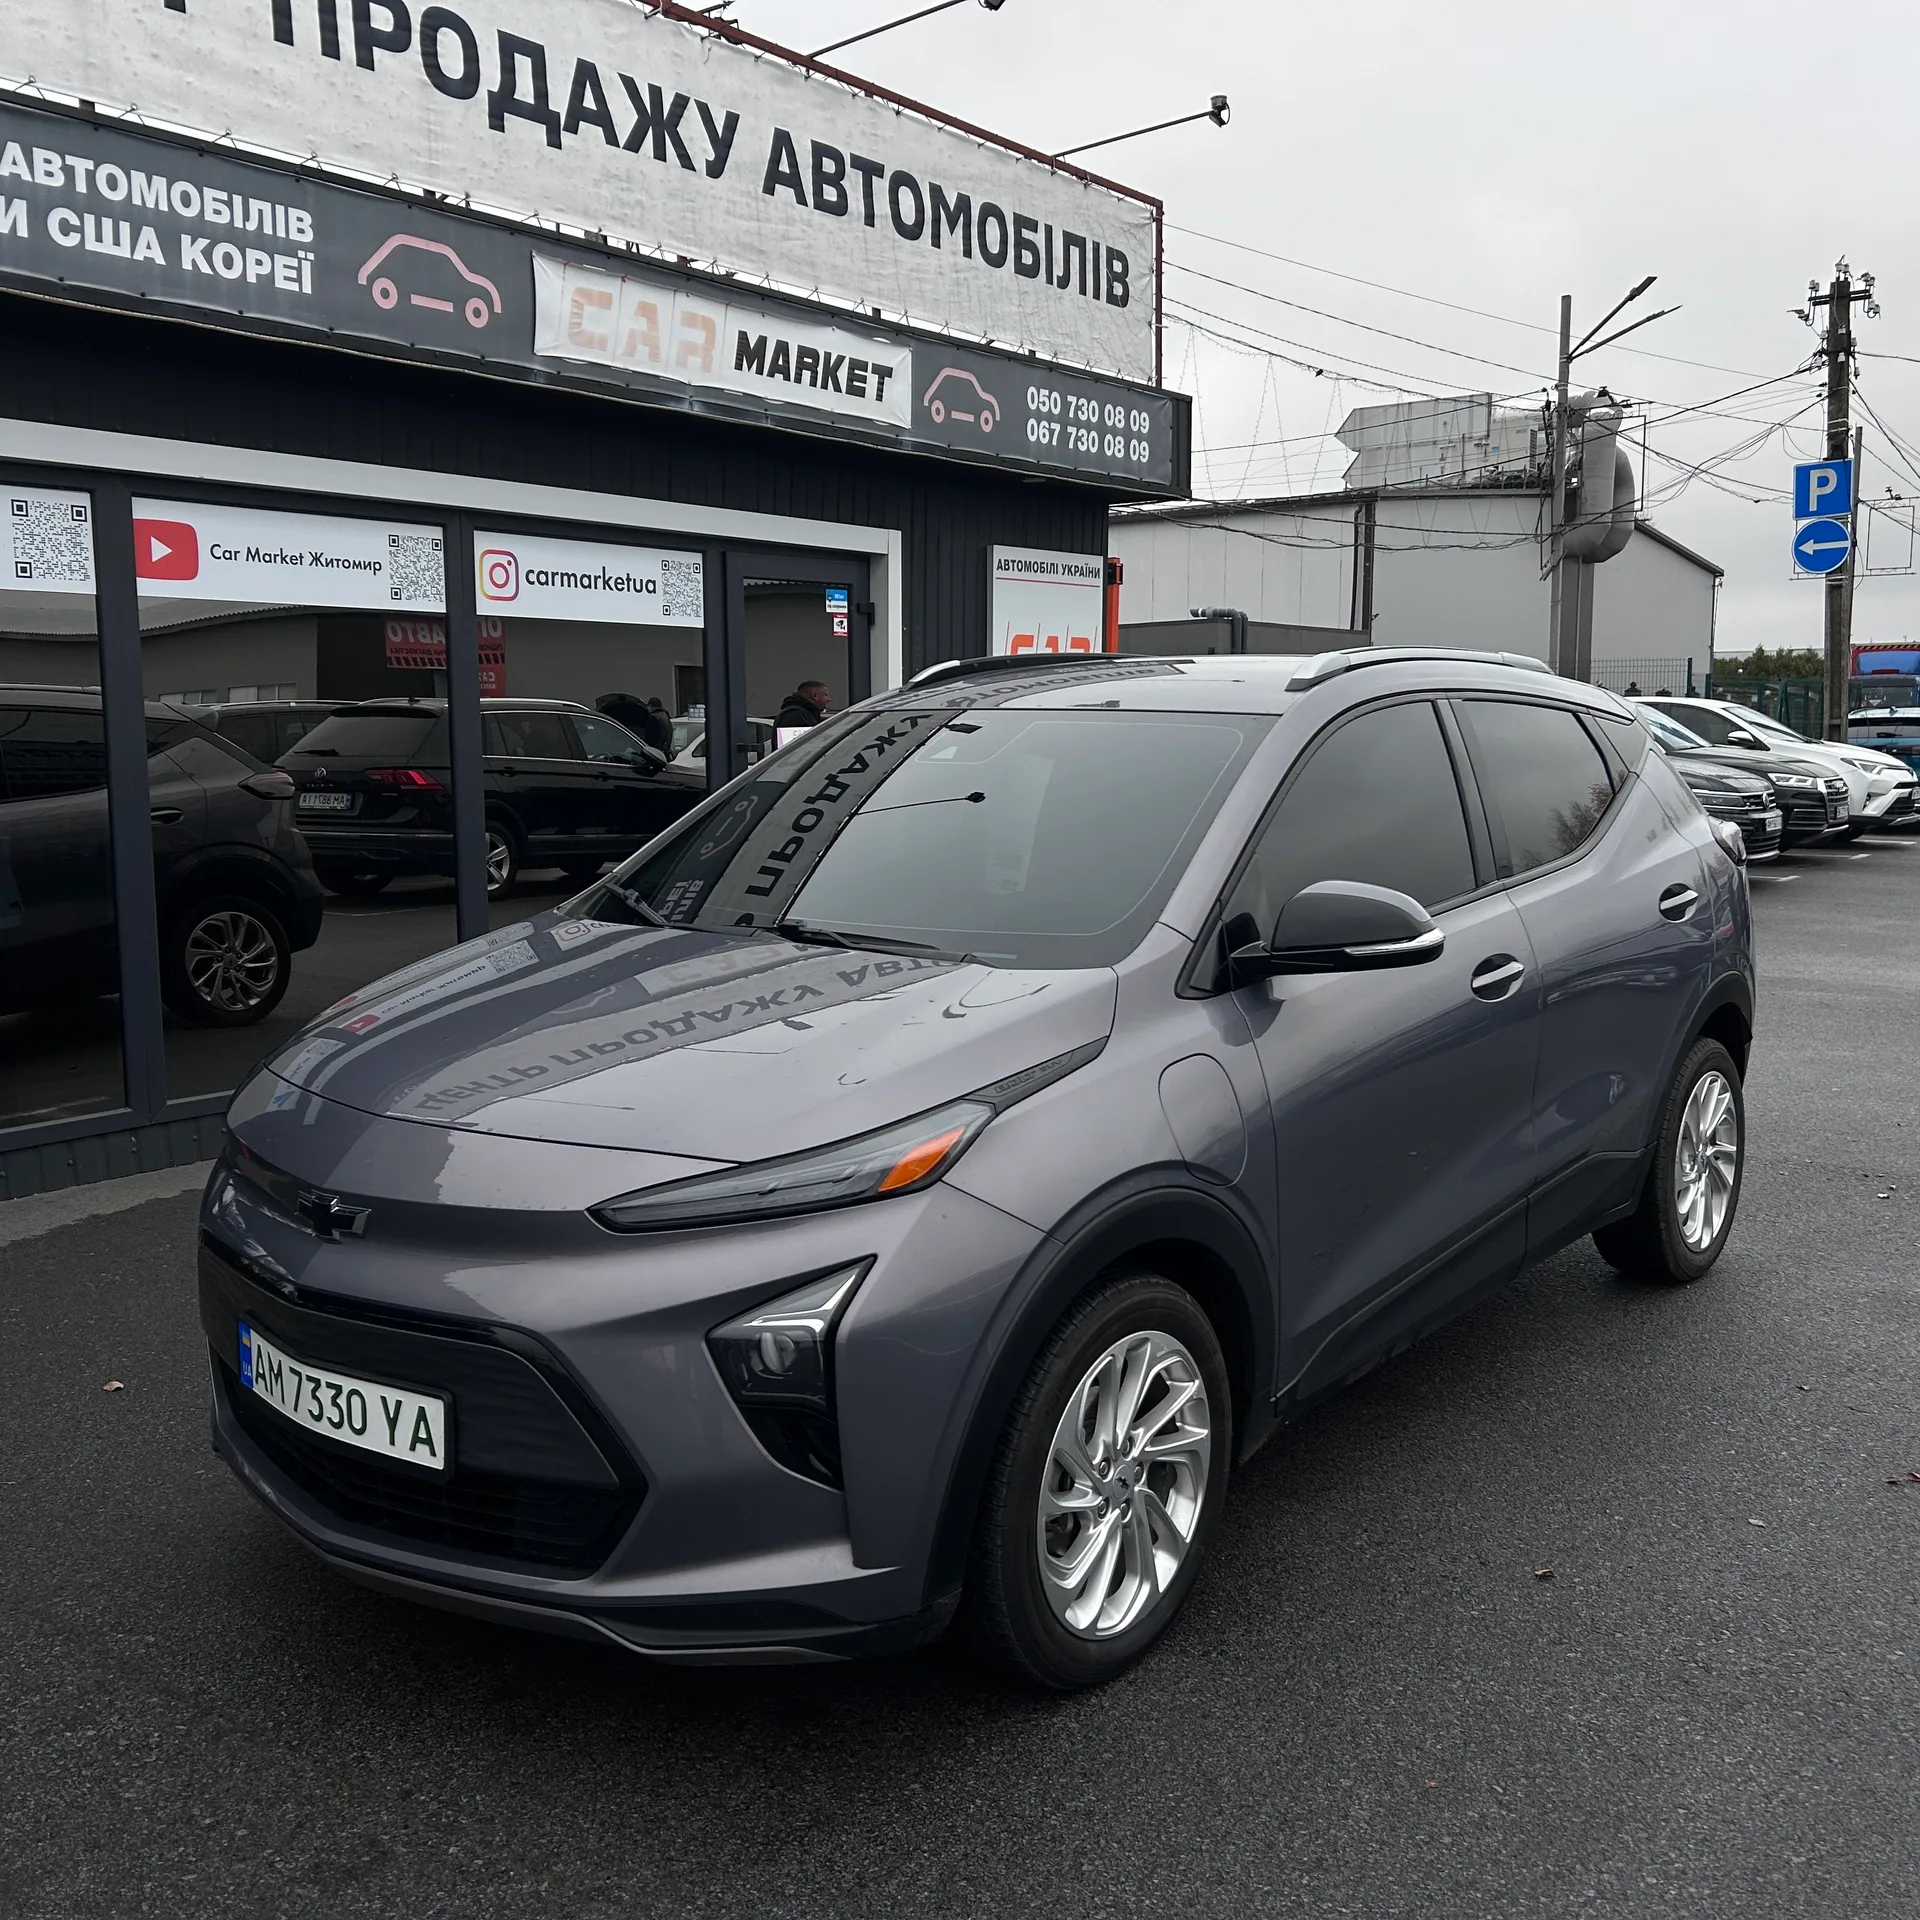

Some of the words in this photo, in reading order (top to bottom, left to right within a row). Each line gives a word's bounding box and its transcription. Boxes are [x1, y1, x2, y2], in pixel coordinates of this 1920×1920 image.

[0, 141, 314, 243] АВТОМОБІЛІВ
[762, 127, 1130, 308] АВТОМОБІЛІВ
[47, 207, 167, 265] США
[180, 233, 315, 294] КОРЕЇ
[568, 286, 717, 373] CAR
[734, 329, 894, 402] MARKET
[1027, 386, 1061, 415] 050
[1067, 395, 1099, 423] 730
[1104, 404, 1125, 428] 08
[1130, 410, 1149, 434] 09
[1027, 418, 1061, 446] 067
[1067, 426, 1099, 453] 730
[1104, 434, 1125, 458] 08
[1130, 439, 1149, 463] 09
[1810, 468, 1838, 511] P
[210, 543, 240, 561] Car
[245, 546, 304, 566] Market
[308, 551, 382, 575] Житомир
[525, 566, 657, 595] carmarketua
[996, 558, 1058, 575] АВТОМОБІЛІ
[1061, 563, 1100, 579] УКРАЇНИ
